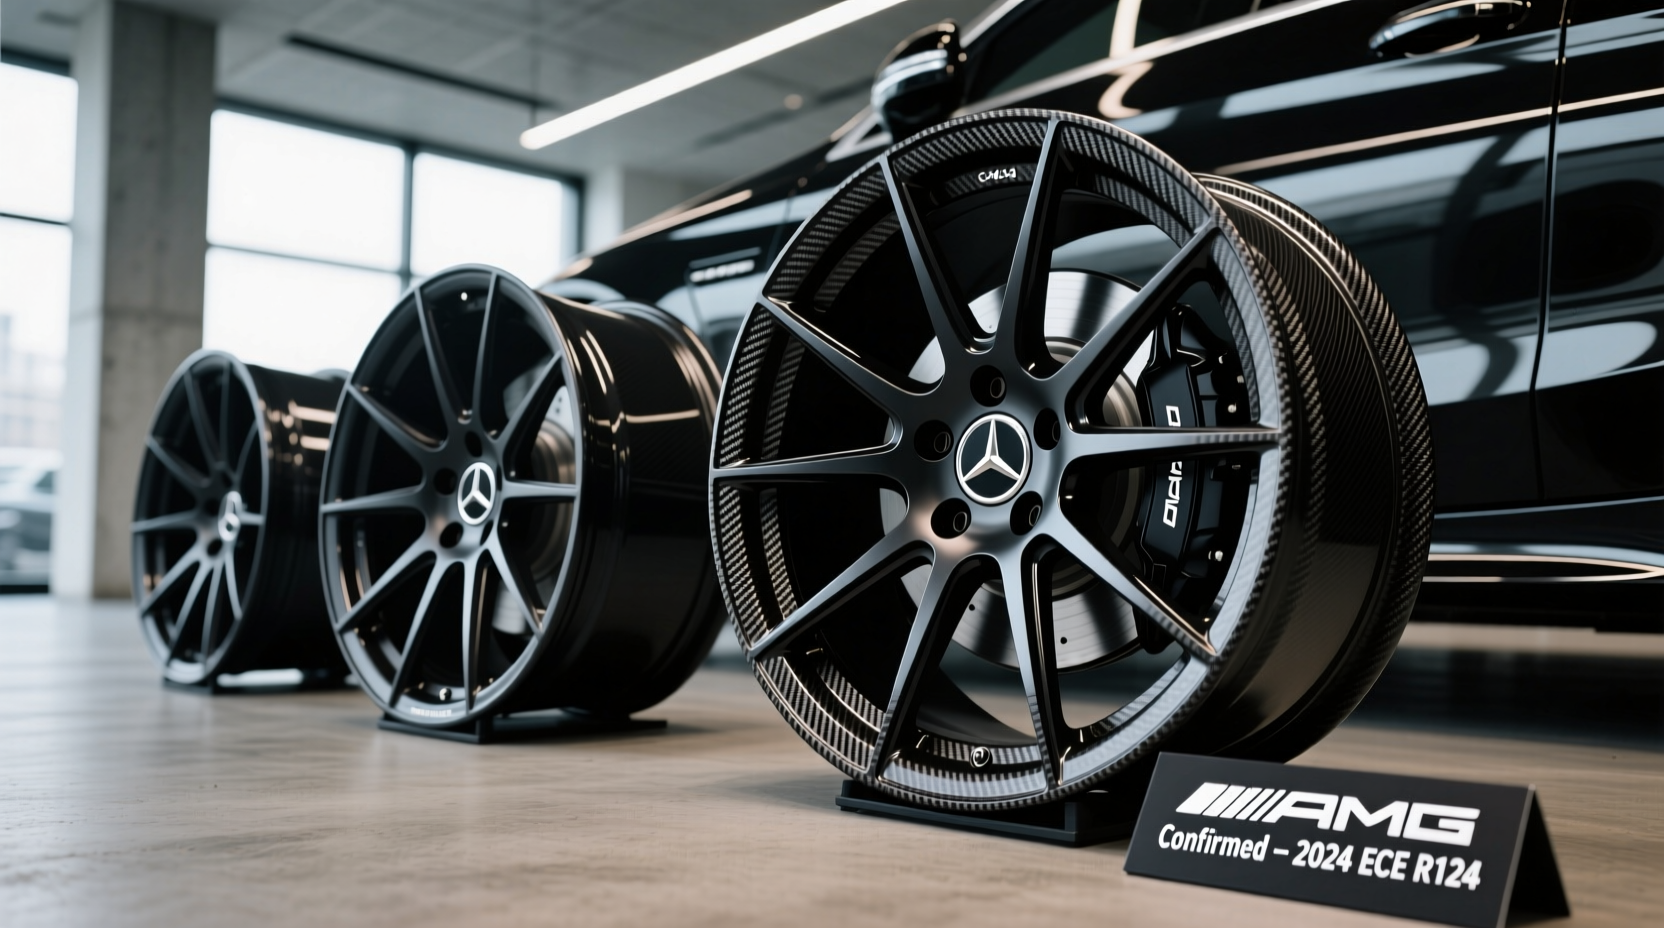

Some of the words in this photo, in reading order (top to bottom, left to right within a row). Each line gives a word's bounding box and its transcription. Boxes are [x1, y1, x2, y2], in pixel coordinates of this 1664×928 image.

[1262, 789, 1481, 847] AMG
[1158, 823, 1271, 862] Confirmed
[1291, 839, 1355, 873] 2024
[1357, 846, 1411, 881] ECE
[1412, 852, 1483, 891] R124
